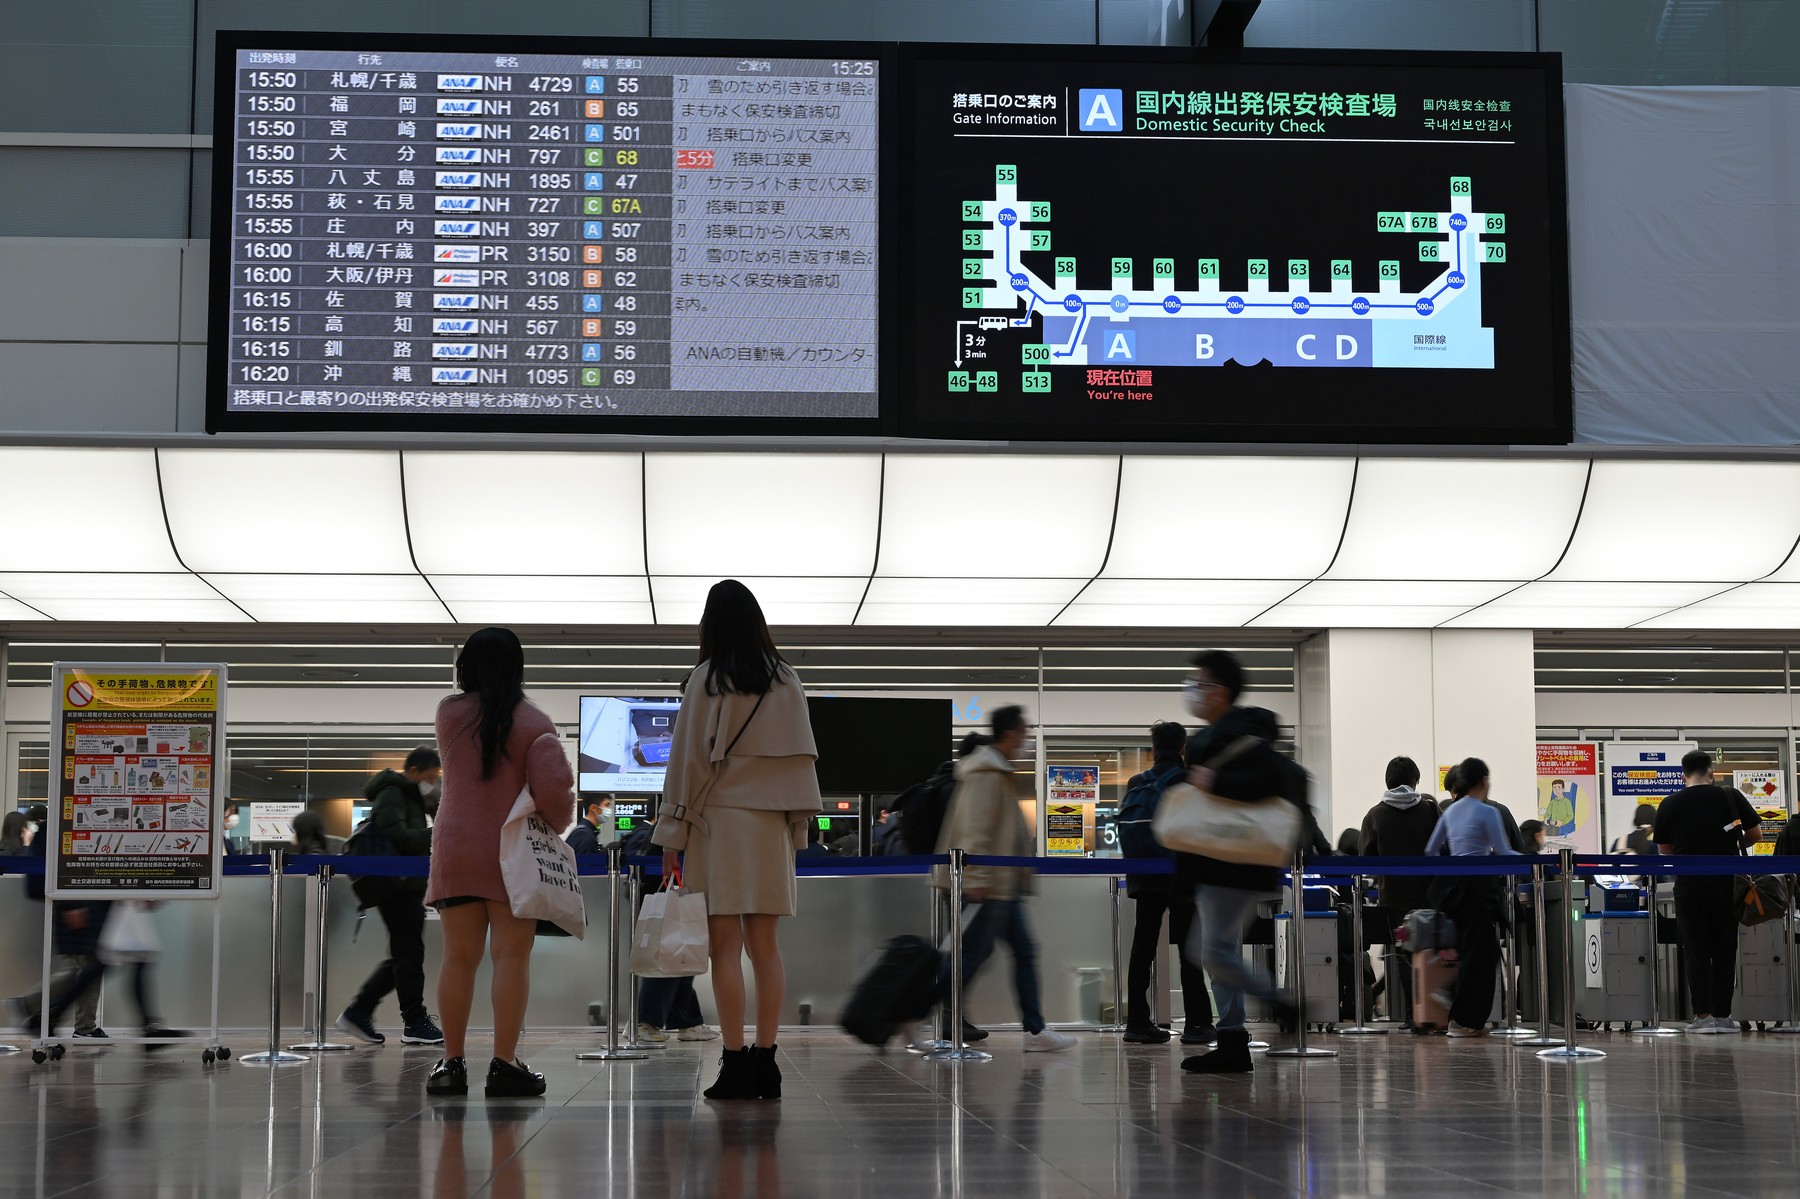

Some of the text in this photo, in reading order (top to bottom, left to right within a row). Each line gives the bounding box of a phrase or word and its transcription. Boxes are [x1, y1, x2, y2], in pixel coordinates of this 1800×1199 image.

[249, 52, 296, 64] 出発時刻
[358, 54, 382, 66] 行先
[495, 56, 519, 68] 便名
[736, 60, 771, 72] ご案内
[831, 62, 874, 76] 15:25
[248, 72, 638, 92] 15:50 札幌/千歳 NH 4729 A 55
[247, 96, 638, 117] 15:50 261 B 65
[953, 94, 1056, 109] 搭乗口のご案内
[1136, 91, 1397, 118] 国内線出発保安検査場
[1424, 99, 1512, 112] 国内线安全检查
[682, 104, 840, 120] まもなく保安検査締切
[1085, 94, 1117, 126] A
[953, 112, 1057, 125] Gate Information
[247, 121, 640, 141] 15:50 NH 2461 501
[1136, 118, 1326, 135] Domestic Security Check
[1424, 118, 1512, 132] 국내선보안검사
[707, 128, 850, 144] 搭乗口からバス案内
[246, 145, 638, 165] 15:50 797 C 68
[733, 153, 812, 167] 搭乗口変更
[245, 170, 638, 190] 15:55 NH 1895 47
[998, 170, 1015, 181] 55
[1452, 181, 1470, 193] 68
[245, 194, 642, 214] 15:55 萩・石見 727 67A
[706, 201, 786, 216] 搭乗口変更
[964, 206, 982, 217] 54
[1032, 206, 1049, 218] 56
[1000, 214, 1017, 222] 370m
[1378, 216, 1405, 228] 67A
[1412, 216, 1438, 228] 67B
[1450, 218, 1467, 226] 740m
[1486, 218, 1503, 230] 69
[244, 219, 642, 238] 15:55 NH 397 507
[706, 224, 850, 240] 搭乗口からバス案内
[964, 234, 982, 246] 53
[1032, 235, 1049, 247] 57
[244, 243, 637, 263] 16:00 札幌/千歳 PR 3150 58
[1420, 246, 1438, 258] 66
[1487, 246, 1504, 258] 70
[964, 263, 982, 275] 52
[1057, 262, 1074, 273] 58
[1114, 262, 1131, 274] 59
[1155, 262, 1172, 274] 60
[1200, 263, 1216, 275] 61
[1250, 264, 1267, 275] 62
[1290, 264, 1307, 276] 63
[1333, 264, 1350, 276] 64
[1381, 264, 1398, 276] 65
[243, 268, 636, 287] 16:00 大阪/伊丹 PR 3108 62
[680, 274, 840, 289] まもなく保安検査締切
[1011, 278, 1029, 286] 200m
[1447, 276, 1465, 284] 600m
[242, 292, 636, 311] 16:15 455 48
[964, 292, 981, 304] 51
[1064, 300, 1082, 308] 100m
[1114, 300, 1126, 308] 0m
[1164, 301, 1181, 309] 100m
[1292, 302, 1310, 310] 300m
[1352, 302, 1370, 310] 400m
[1416, 303, 1434, 311] 500m
[242, 316, 636, 336] 16:15 NH 567 59
[1106, 333, 1132, 358] A
[1414, 334, 1446, 345] 国際線
[241, 341, 636, 360] 16:15 4773 56
[1196, 334, 1215, 360] B
[1296, 334, 1317, 360] C
[1336, 334, 1358, 360] D
[1024, 348, 1049, 360] 500
[241, 365, 636, 384] 16:20 NH 1095 C 69
[1086, 370, 1152, 386] 現在位置
[950, 376, 967, 388] 46
[978, 376, 996, 388] 48
[1025, 376, 1049, 388] 513
[233, 390, 618, 410] 搭乗口と最寄りの出発保安検査場をお確かめ下さい。
[1087, 390, 1153, 400] You're here
[620, 820, 629, 828] 48
[1104, 823, 1118, 844] 5
[536, 858, 565, 874] want
[538, 868, 582, 894] have fu
